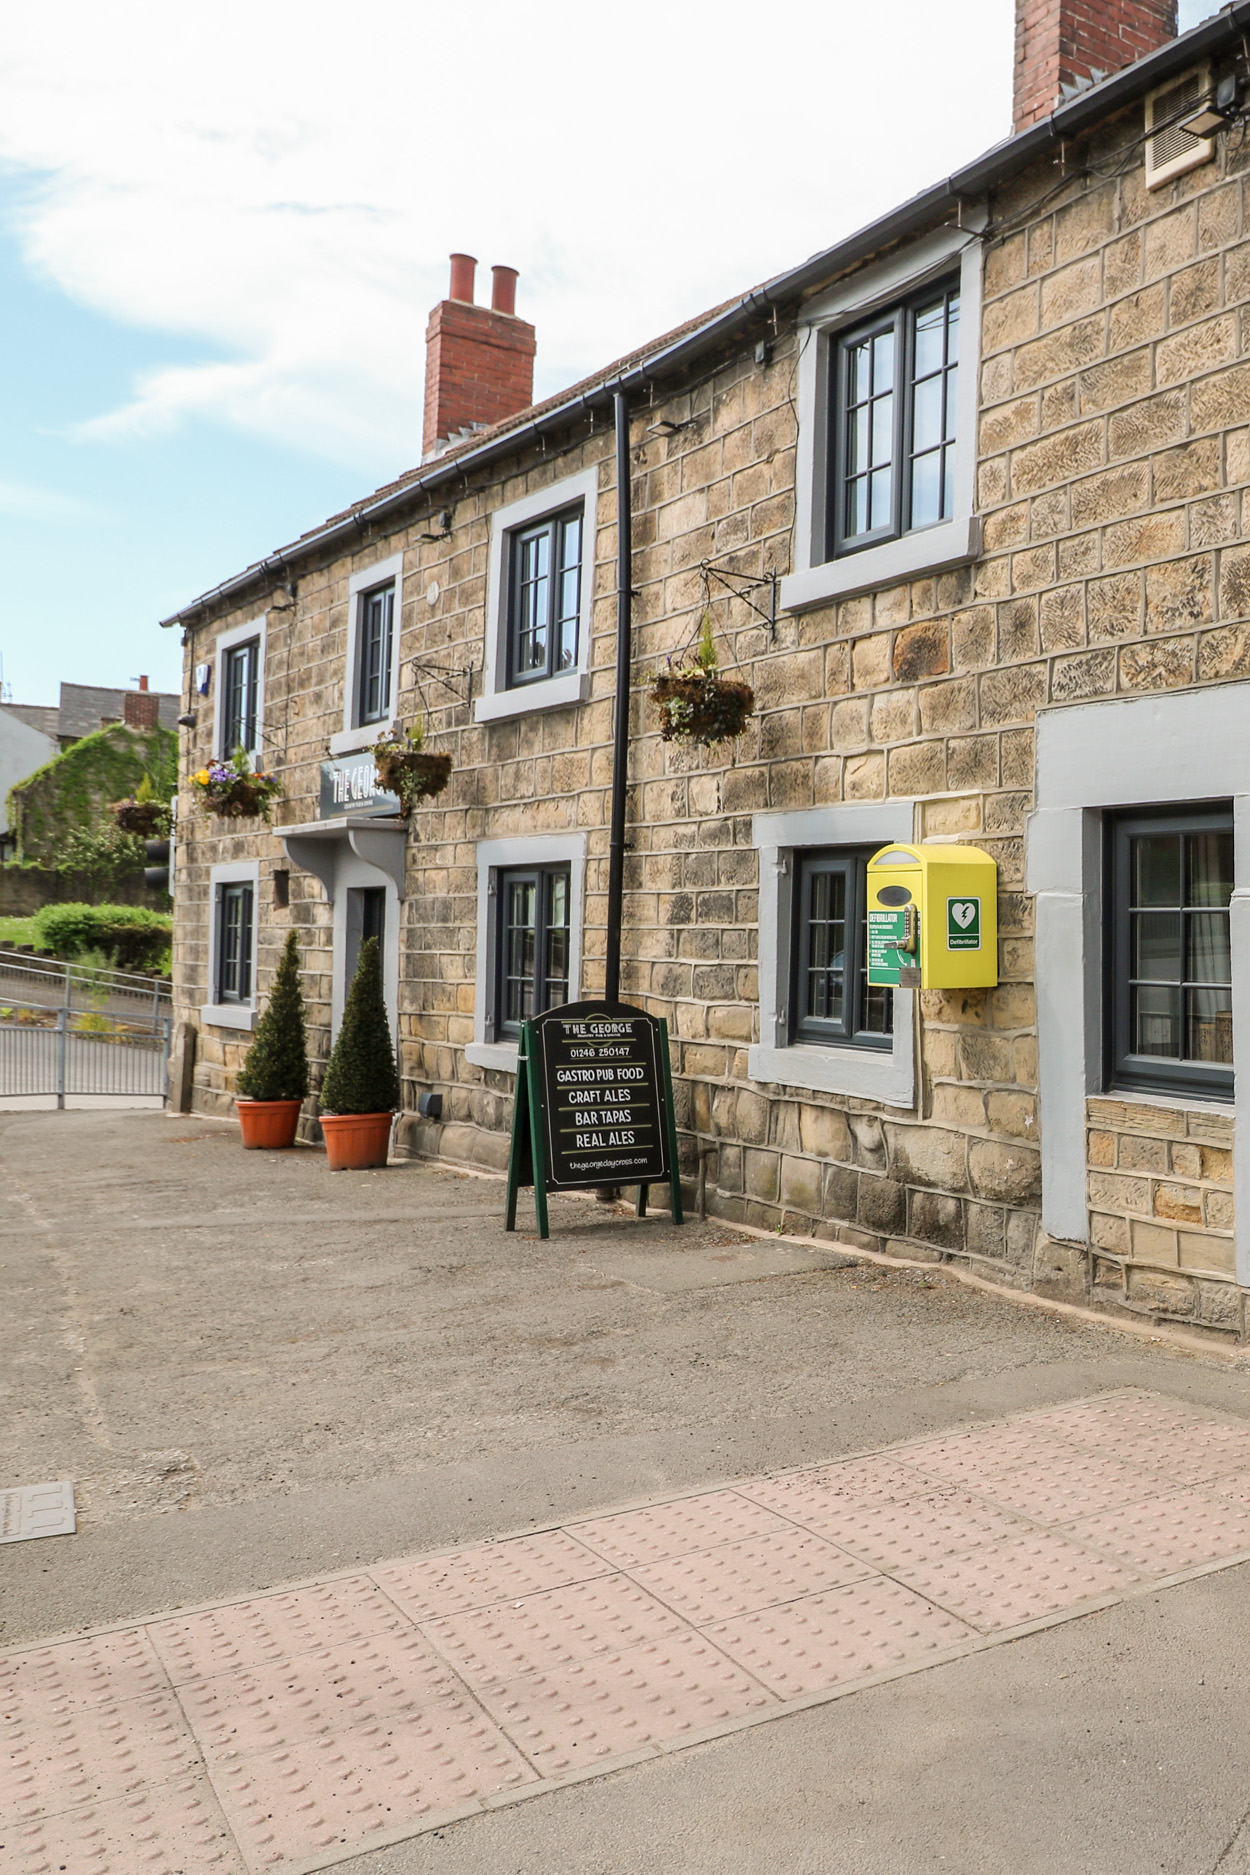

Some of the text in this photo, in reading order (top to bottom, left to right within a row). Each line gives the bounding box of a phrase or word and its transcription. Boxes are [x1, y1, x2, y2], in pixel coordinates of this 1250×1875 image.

[333, 769, 350, 803] THE
[870, 913, 898, 922] DEFIBRILLATOR
[562, 1023, 632, 1034] THE GEORGE
[570, 1048, 630, 1058] 01246 250147
[557, 1068, 644, 1082] GASTRO PUB FOOD
[568, 1088, 631, 1104] CRAFT ALES
[576, 1110, 632, 1126] BAR TAPAS
[576, 1130, 635, 1148] REAL ALES
[570, 1158, 648, 1171] thegeorgedaycross.com
